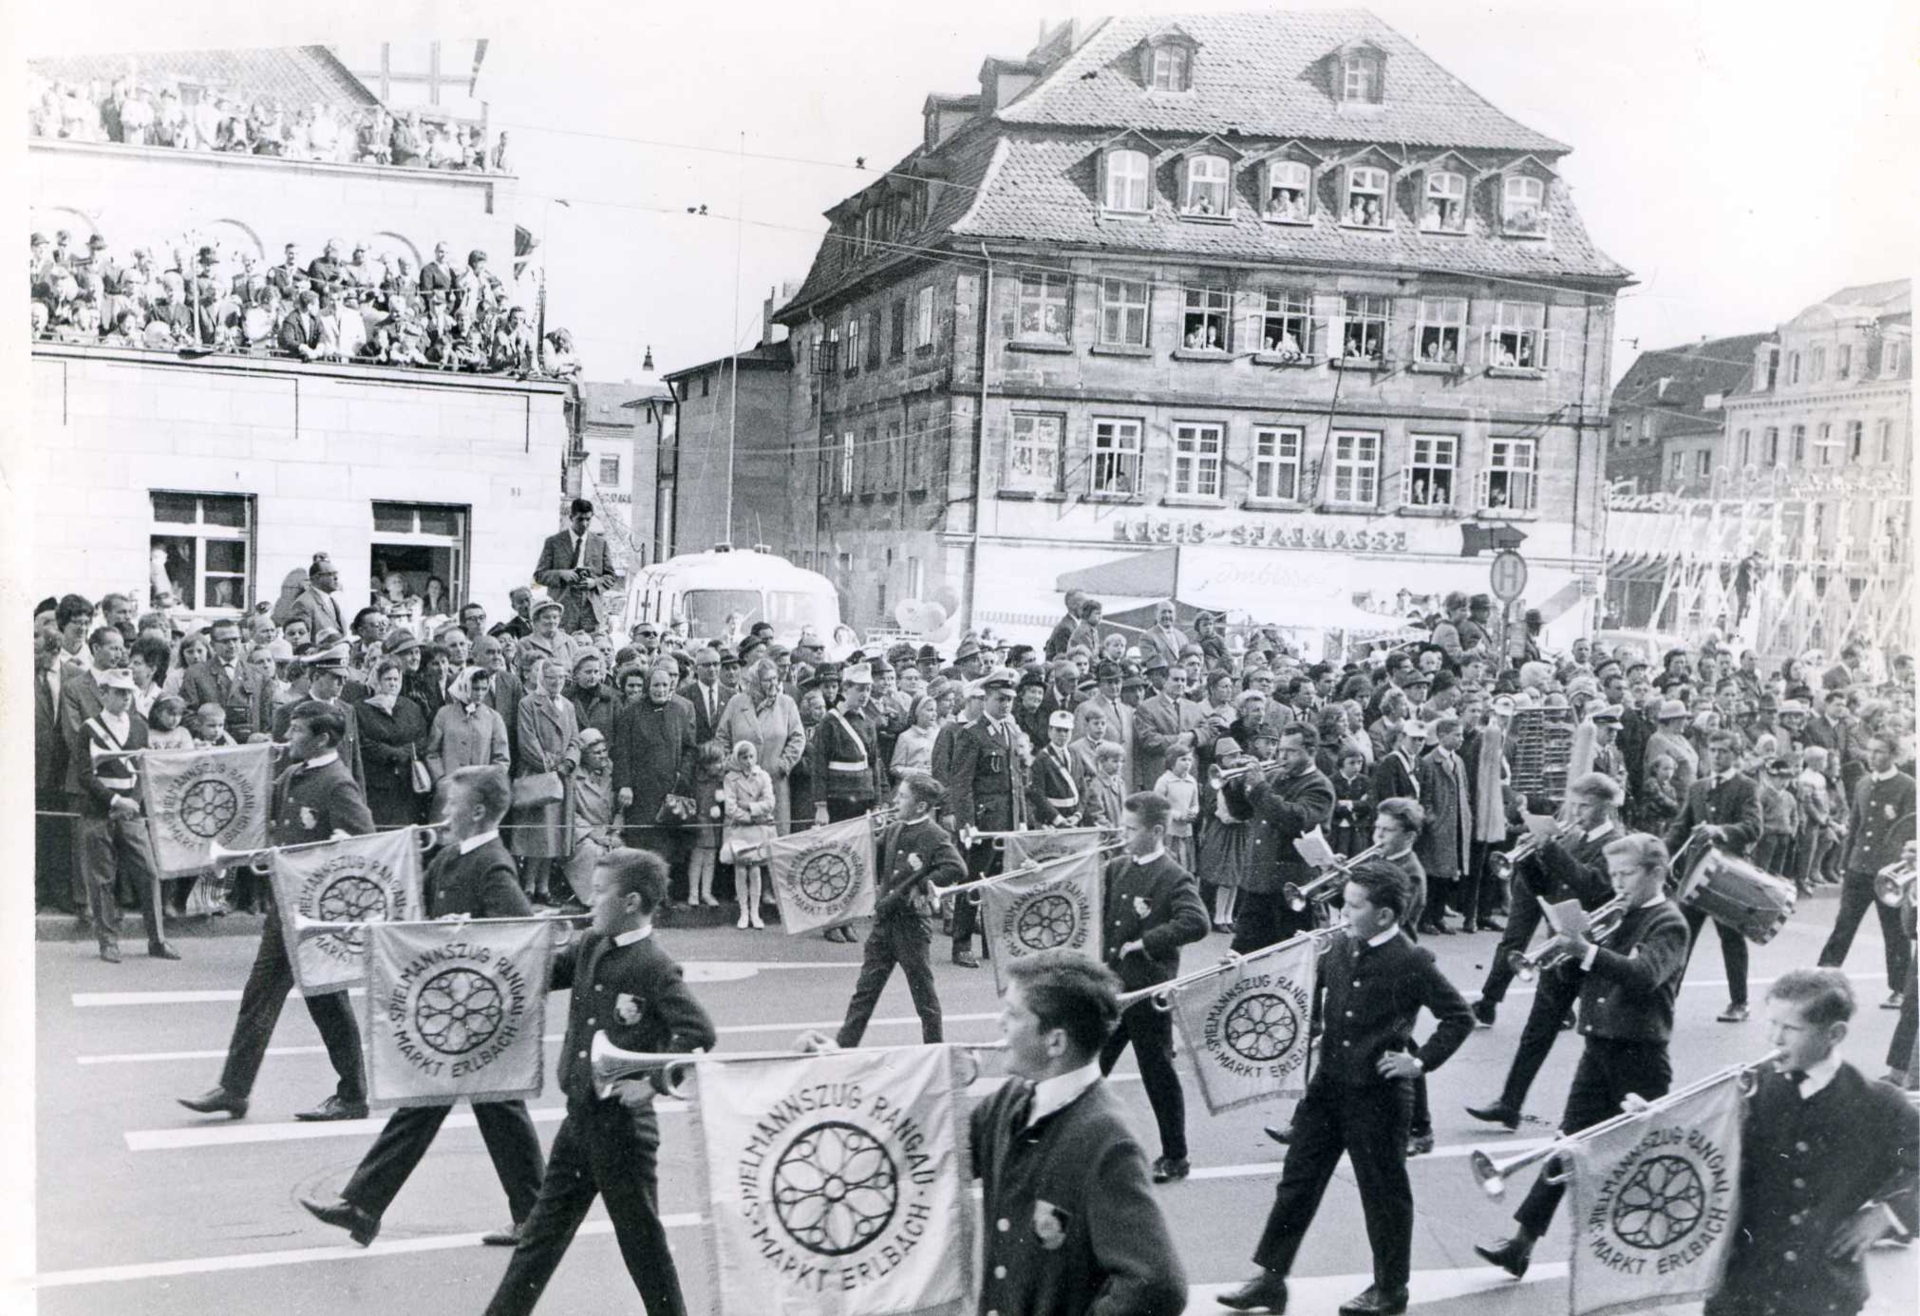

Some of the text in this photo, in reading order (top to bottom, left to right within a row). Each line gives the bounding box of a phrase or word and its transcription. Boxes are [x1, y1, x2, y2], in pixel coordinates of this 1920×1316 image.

[1500, 559, 1518, 591] H
[390, 943, 525, 1022] SPIELMANNSZUG RANGAU
[1204, 974, 1271, 1051] SPIELMANNSZUG
[394, 1025, 518, 1079] MARKT ERLBACH
[1215, 1052, 1263, 1078] MARKT
[739, 1084, 935, 1217] SPIELMANNSZUG RANGAU
[1589, 1126, 1730, 1233] SPIELMANNSZUG RANGAU
[752, 1203, 932, 1292] MARKT ERLBACH
[1591, 1207, 1728, 1274] MARKT ERLBACH
